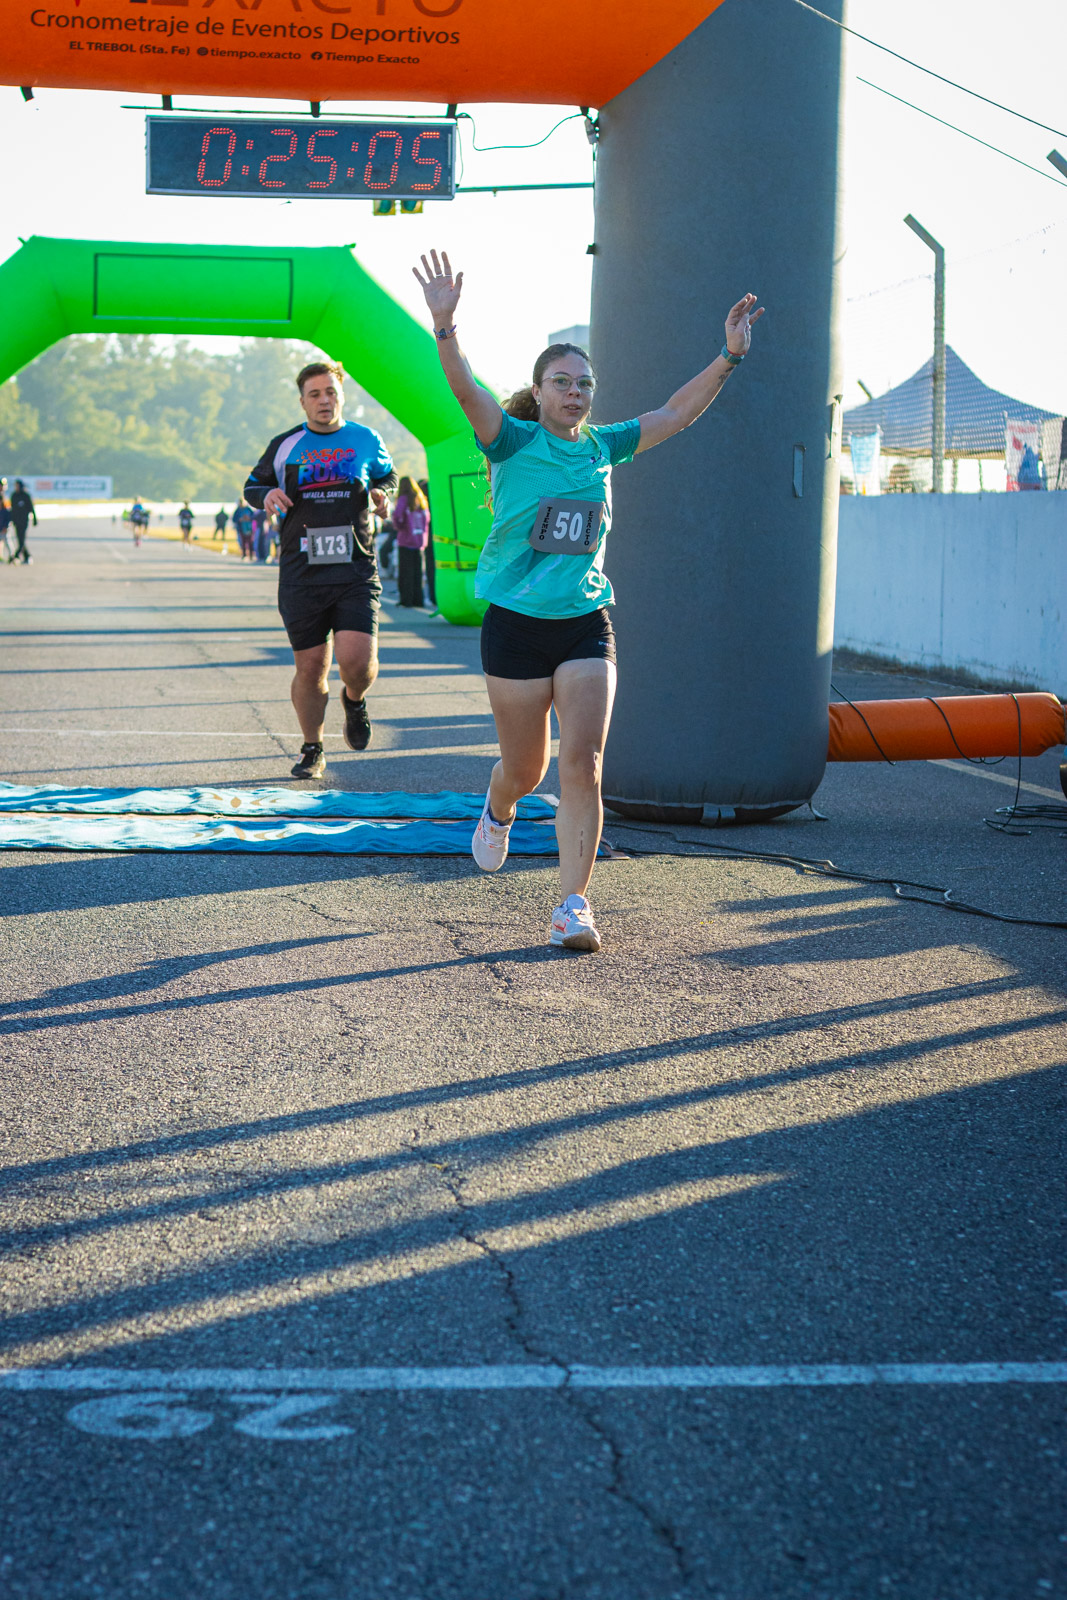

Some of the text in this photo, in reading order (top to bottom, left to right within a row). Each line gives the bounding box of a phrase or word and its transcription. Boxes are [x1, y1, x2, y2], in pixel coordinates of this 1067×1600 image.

[30, 9, 189, 37] Cronometraje
[195, 16, 225, 35] de
[232, 18, 323, 39] Eventos
[331, 22, 460, 45] Deportivos
[69, 41, 190, 56] EL TREBOL (Sta. Fe)
[210, 47, 302, 60] tiempo.exacto
[325, 51, 420, 64] Tiempo Exacto
[197, 127, 442, 191] 0:25:05
[539, 506, 553, 540] TIEMPO
[552, 511, 583, 541] 50
[584, 510, 594, 546] EXACTO
[315, 534, 347, 556] 173
